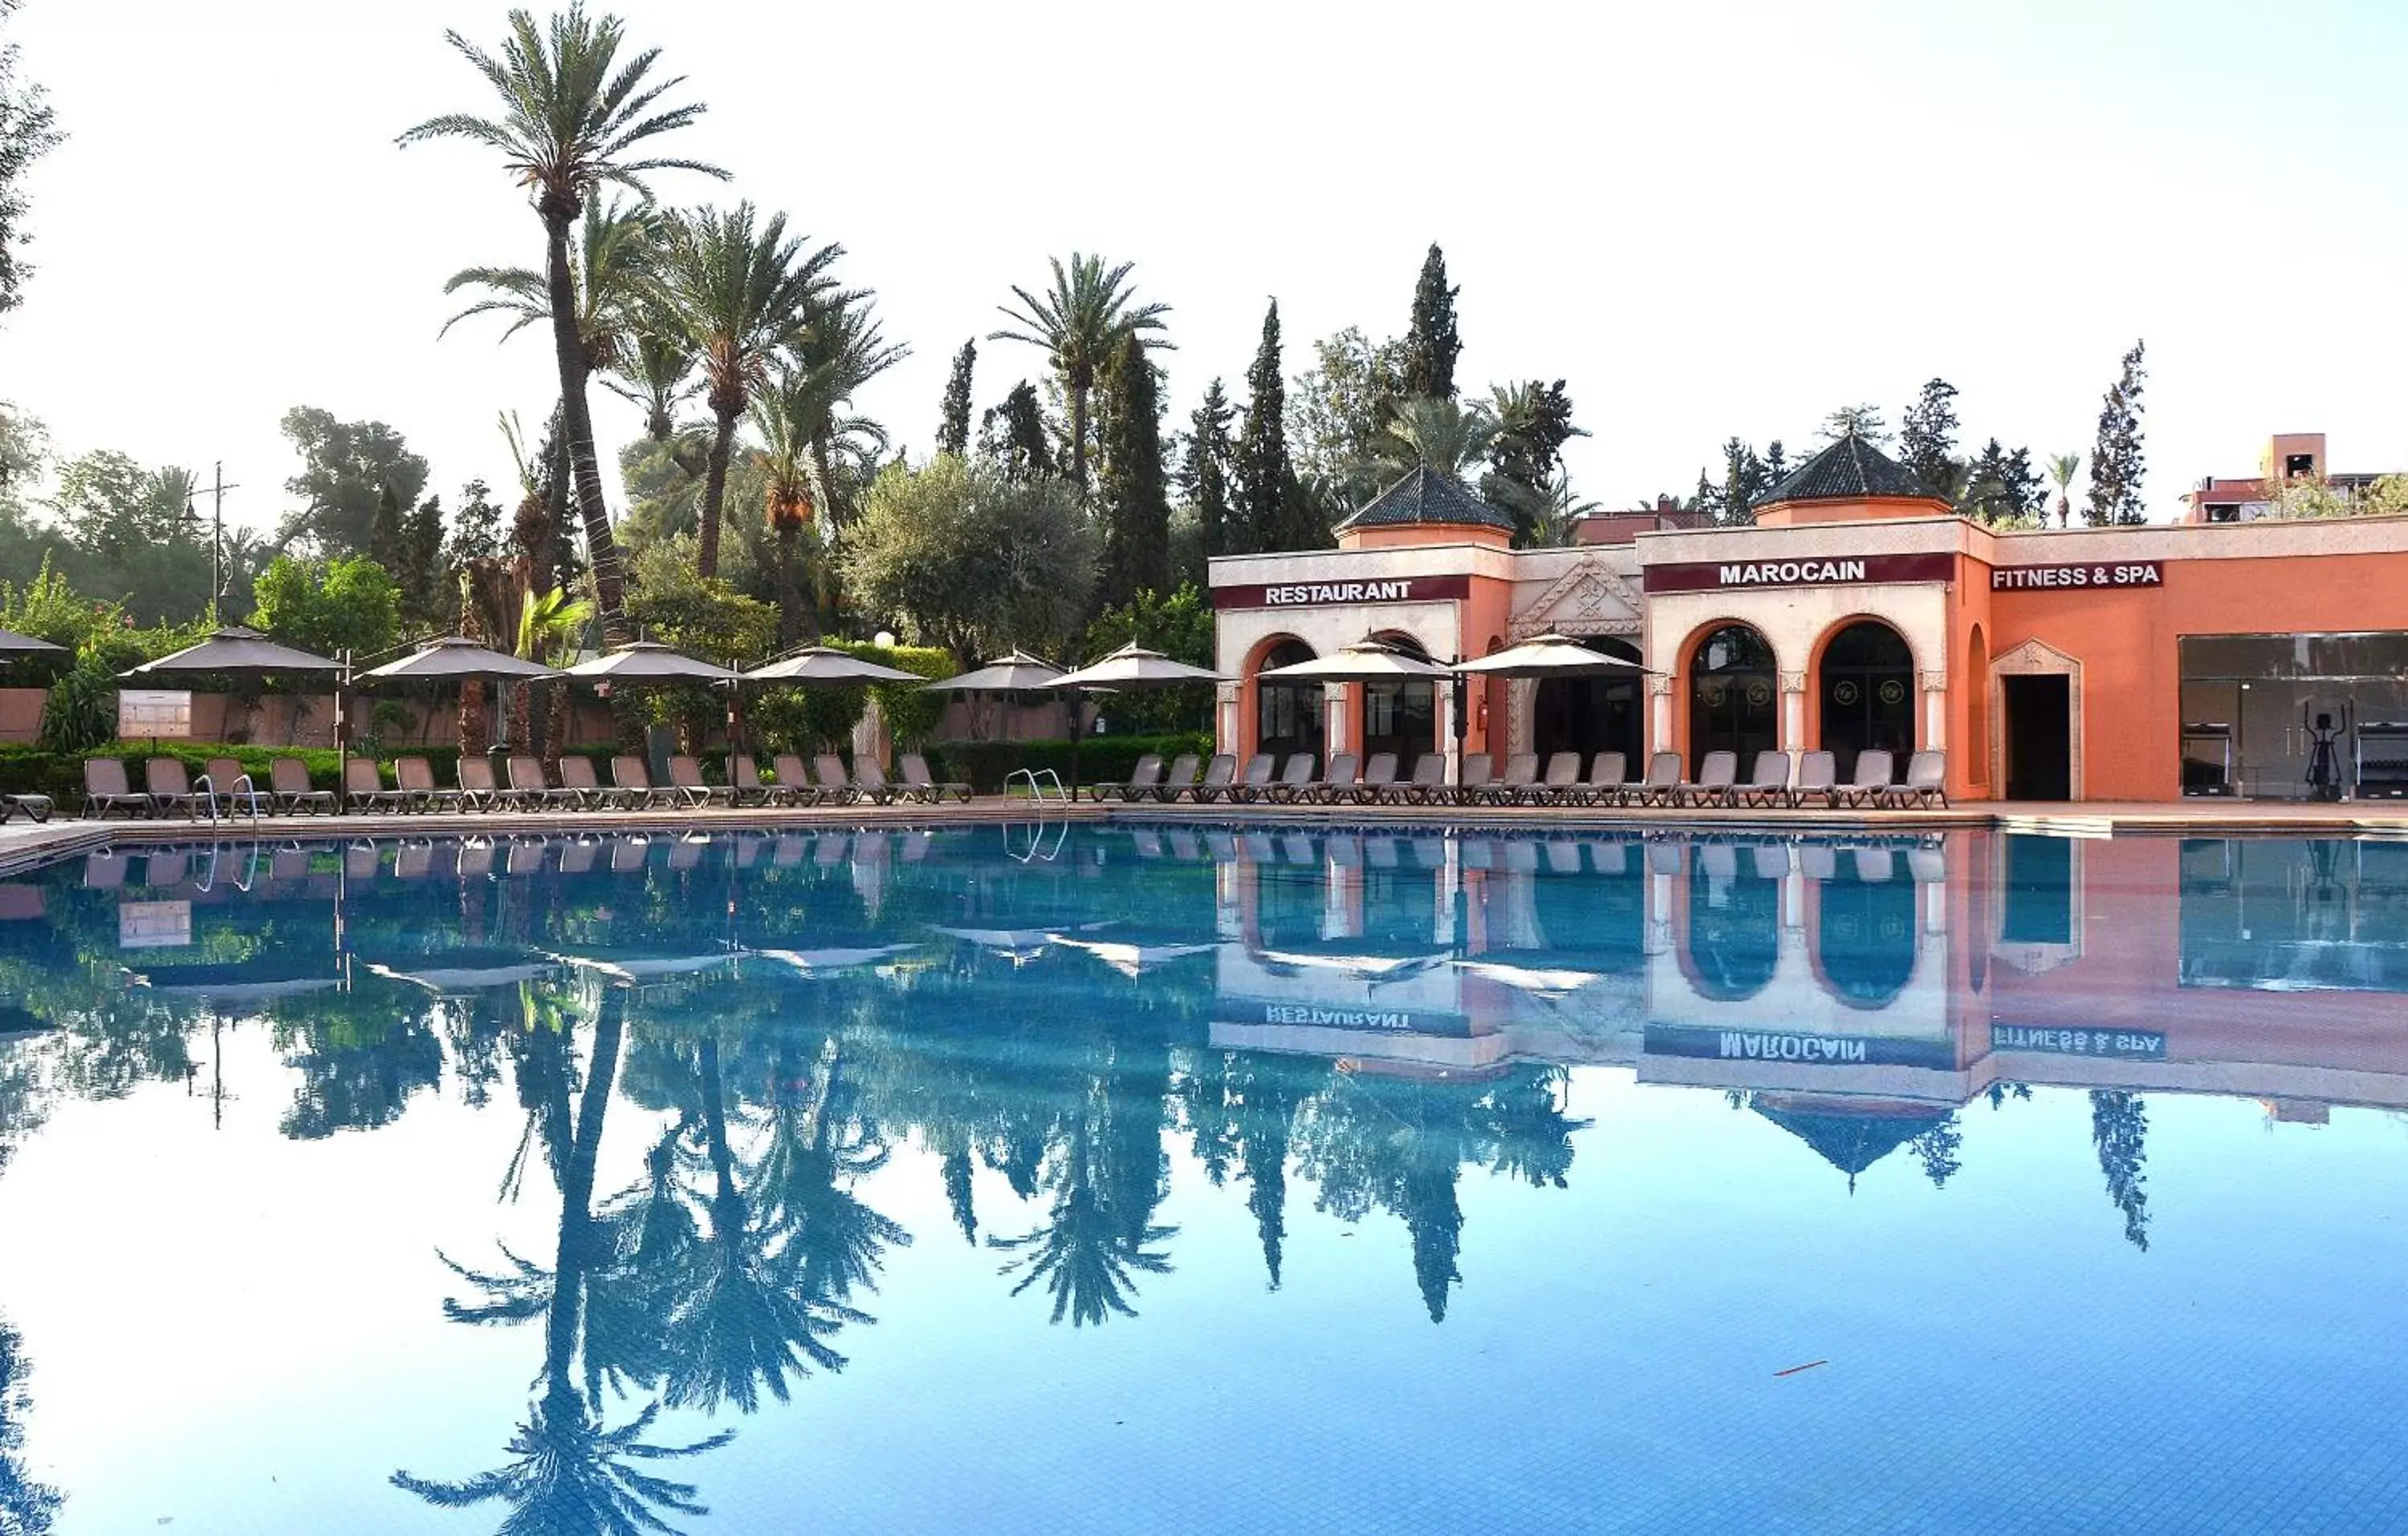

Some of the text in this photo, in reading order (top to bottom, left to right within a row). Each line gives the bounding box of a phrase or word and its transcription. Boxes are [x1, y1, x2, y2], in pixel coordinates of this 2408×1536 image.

[1720, 561, 1865, 583] MAROCAIN
[1993, 565, 2159, 587] FITNESS & SPA
[1266, 581, 1412, 603] RESTAURANT
